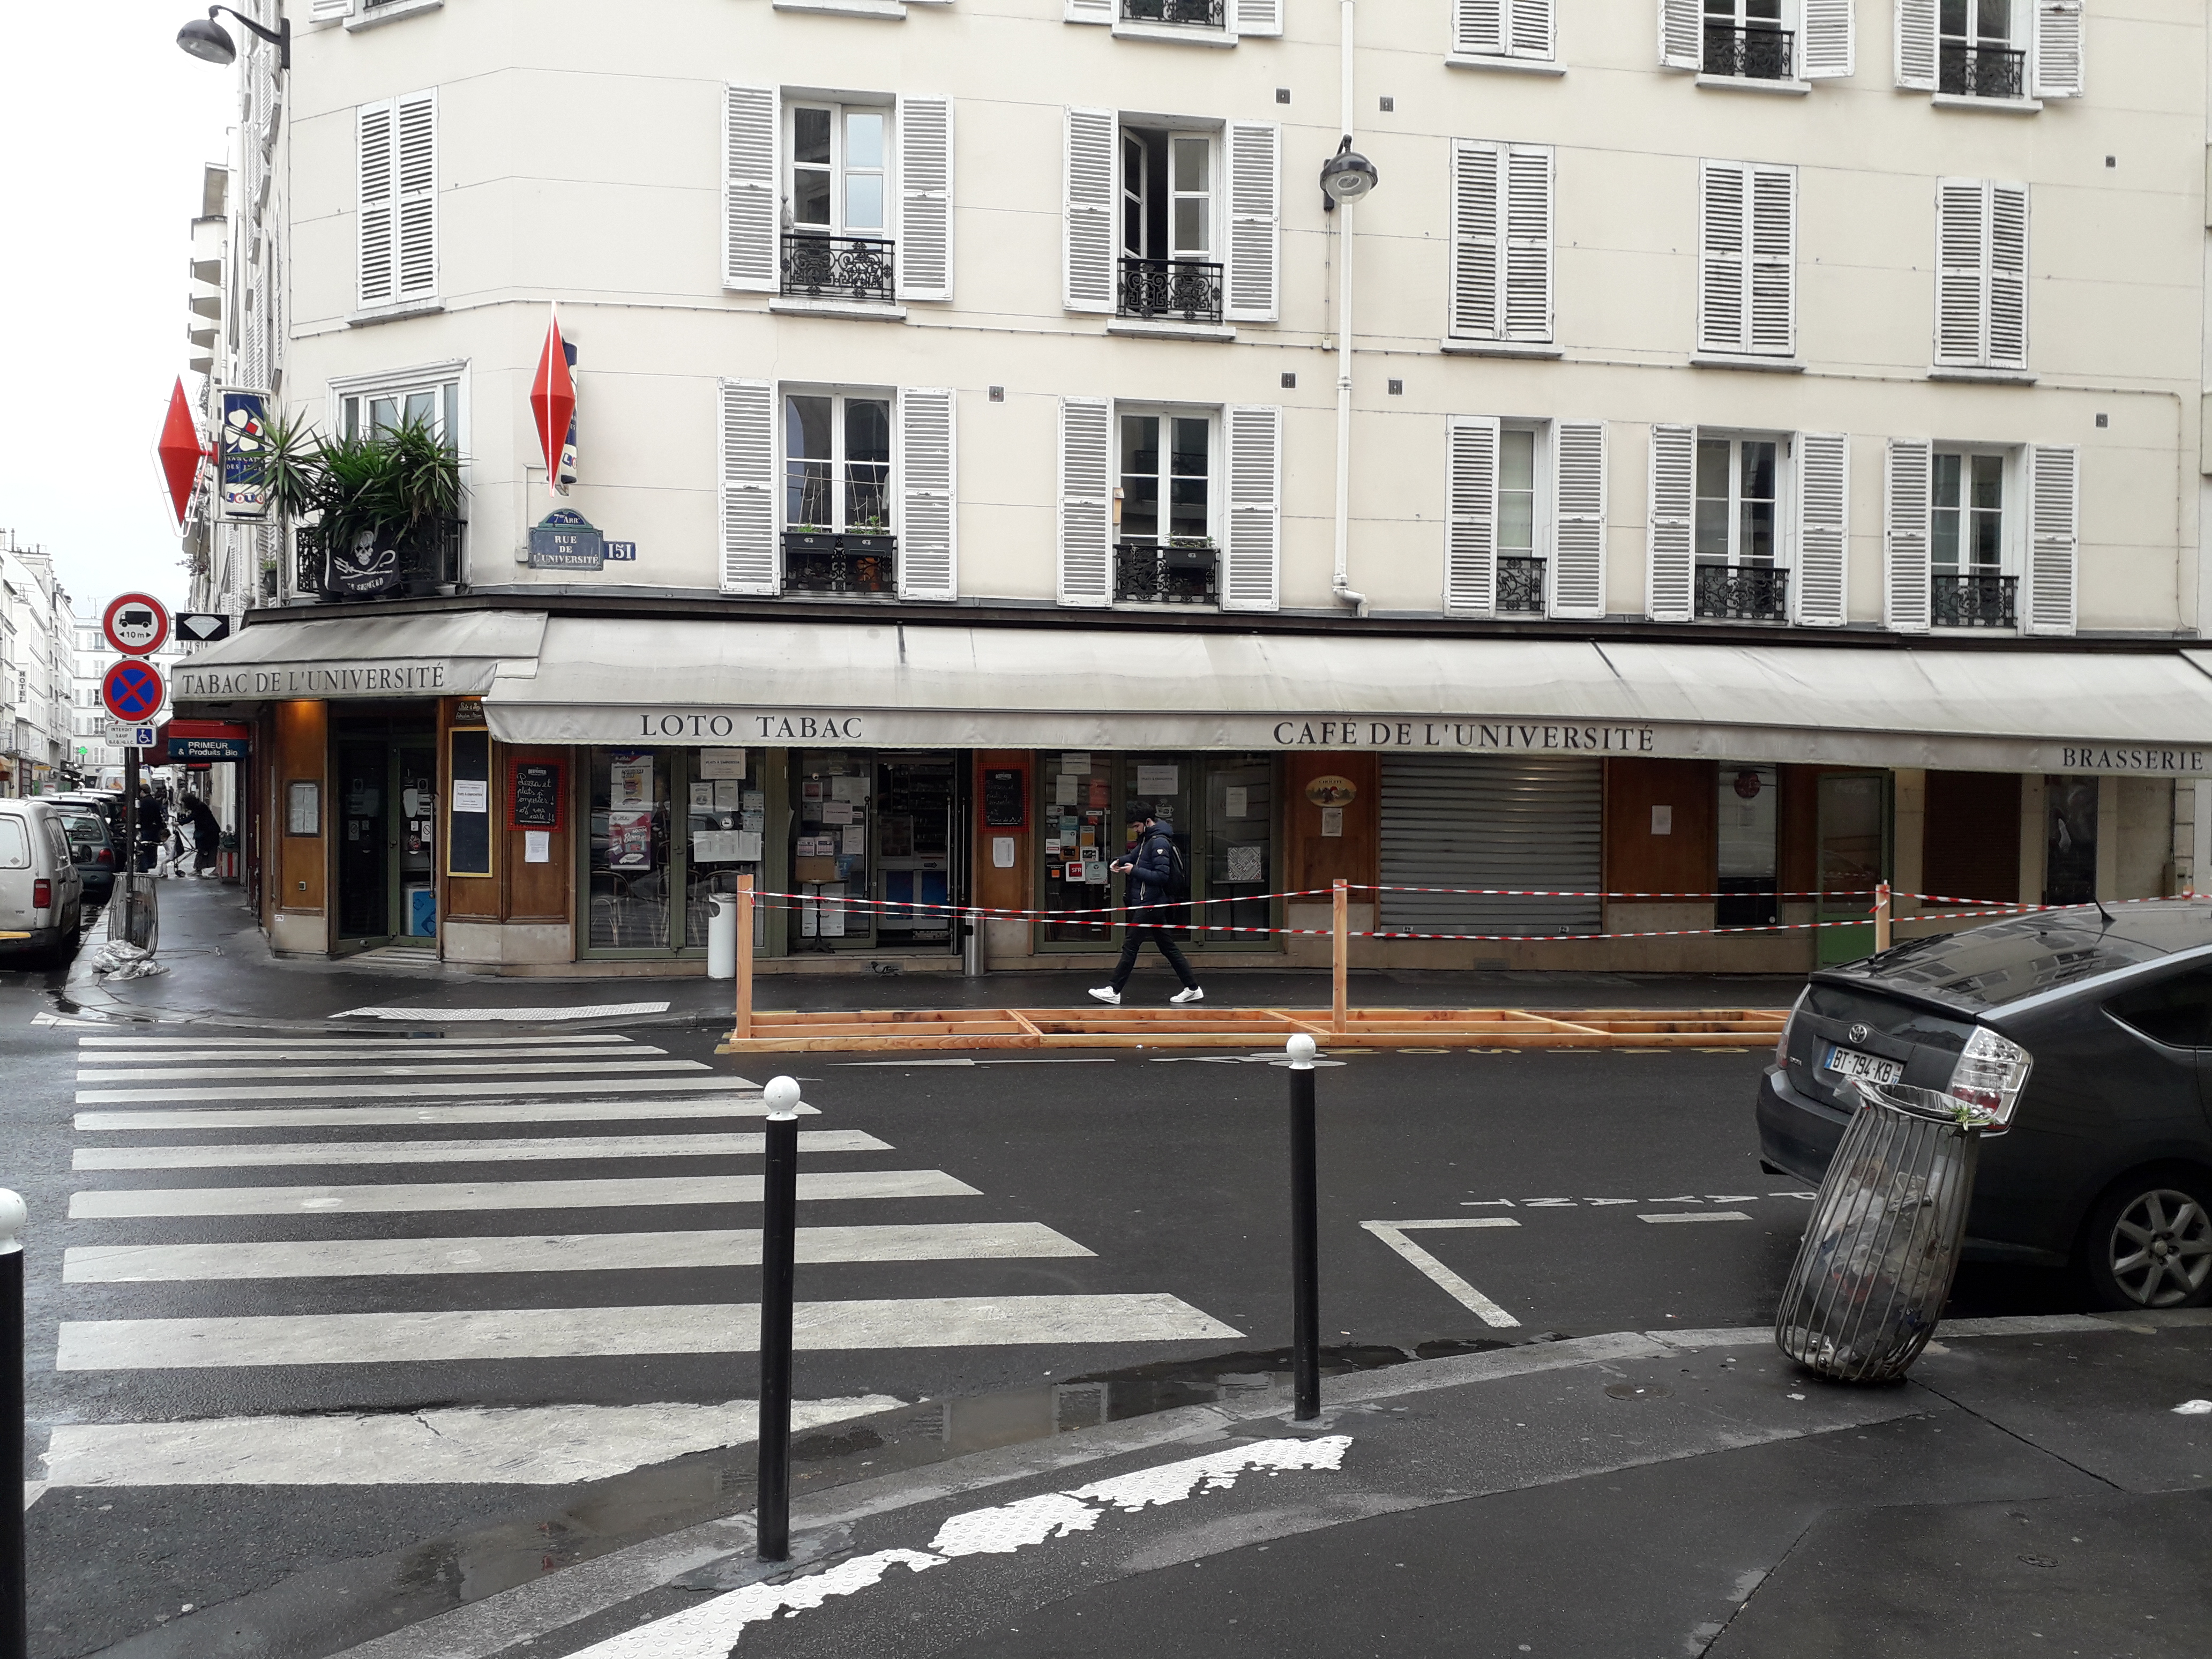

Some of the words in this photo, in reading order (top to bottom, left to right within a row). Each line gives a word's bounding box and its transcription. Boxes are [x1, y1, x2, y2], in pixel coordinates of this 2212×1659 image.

[226, 491, 264, 504] LOTO
[555, 535, 577, 543] RUE
[534, 552, 599, 564] L'UNIVERSITÉ
[608, 543, 632, 559] 151
[183, 674, 247, 694] TABAC
[255, 672, 281, 692] DE
[289, 663, 444, 691] L'UNIVERSITÉ
[640, 714, 734, 737] LOTO
[755, 715, 862, 738] TABAC
[1274, 718, 1357, 745] CAFÉ
[1369, 722, 1411, 745] DE
[1424, 723, 1654, 751] L'UNIVERSITÉ
[2063, 748, 2203, 771] BRASSERIE
[1460, 1192, 1817, 1207] PAYANT
